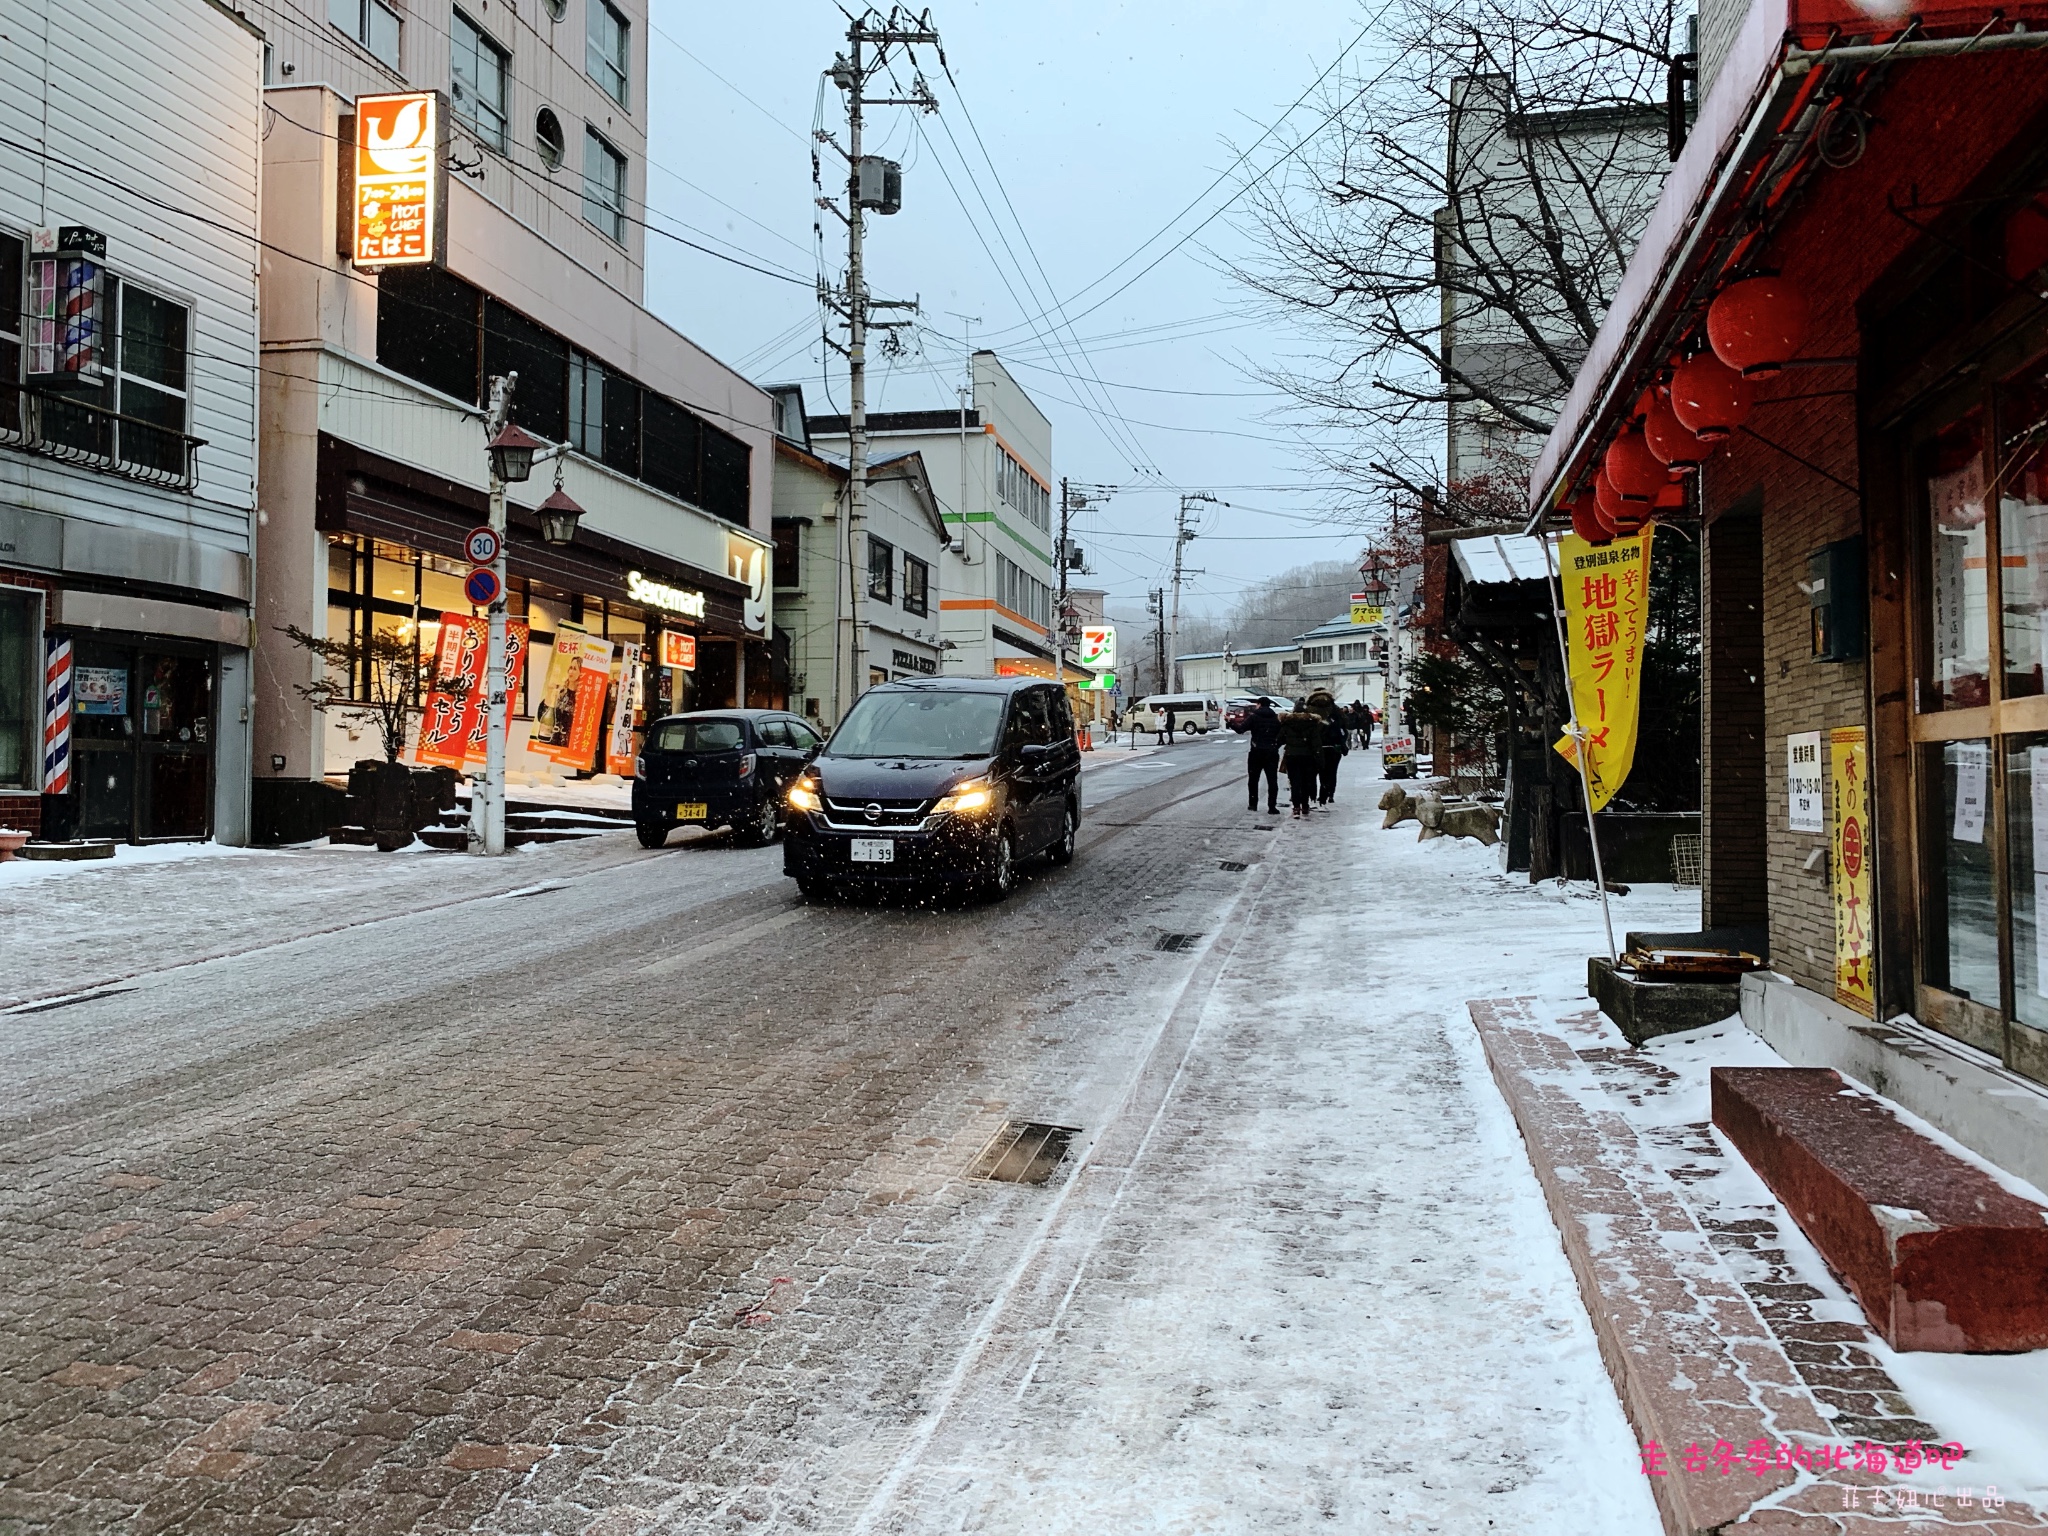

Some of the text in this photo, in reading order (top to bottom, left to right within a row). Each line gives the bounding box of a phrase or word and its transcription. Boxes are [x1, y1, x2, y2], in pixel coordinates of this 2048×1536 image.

[391, 203, 425, 220] HOT
[389, 218, 424, 232] CHEF
[360, 233, 422, 257] たばこ
[473, 538, 493, 555] 30
[1573, 544, 1641, 571] 登別温泉名物
[426, 697, 452, 744] セール
